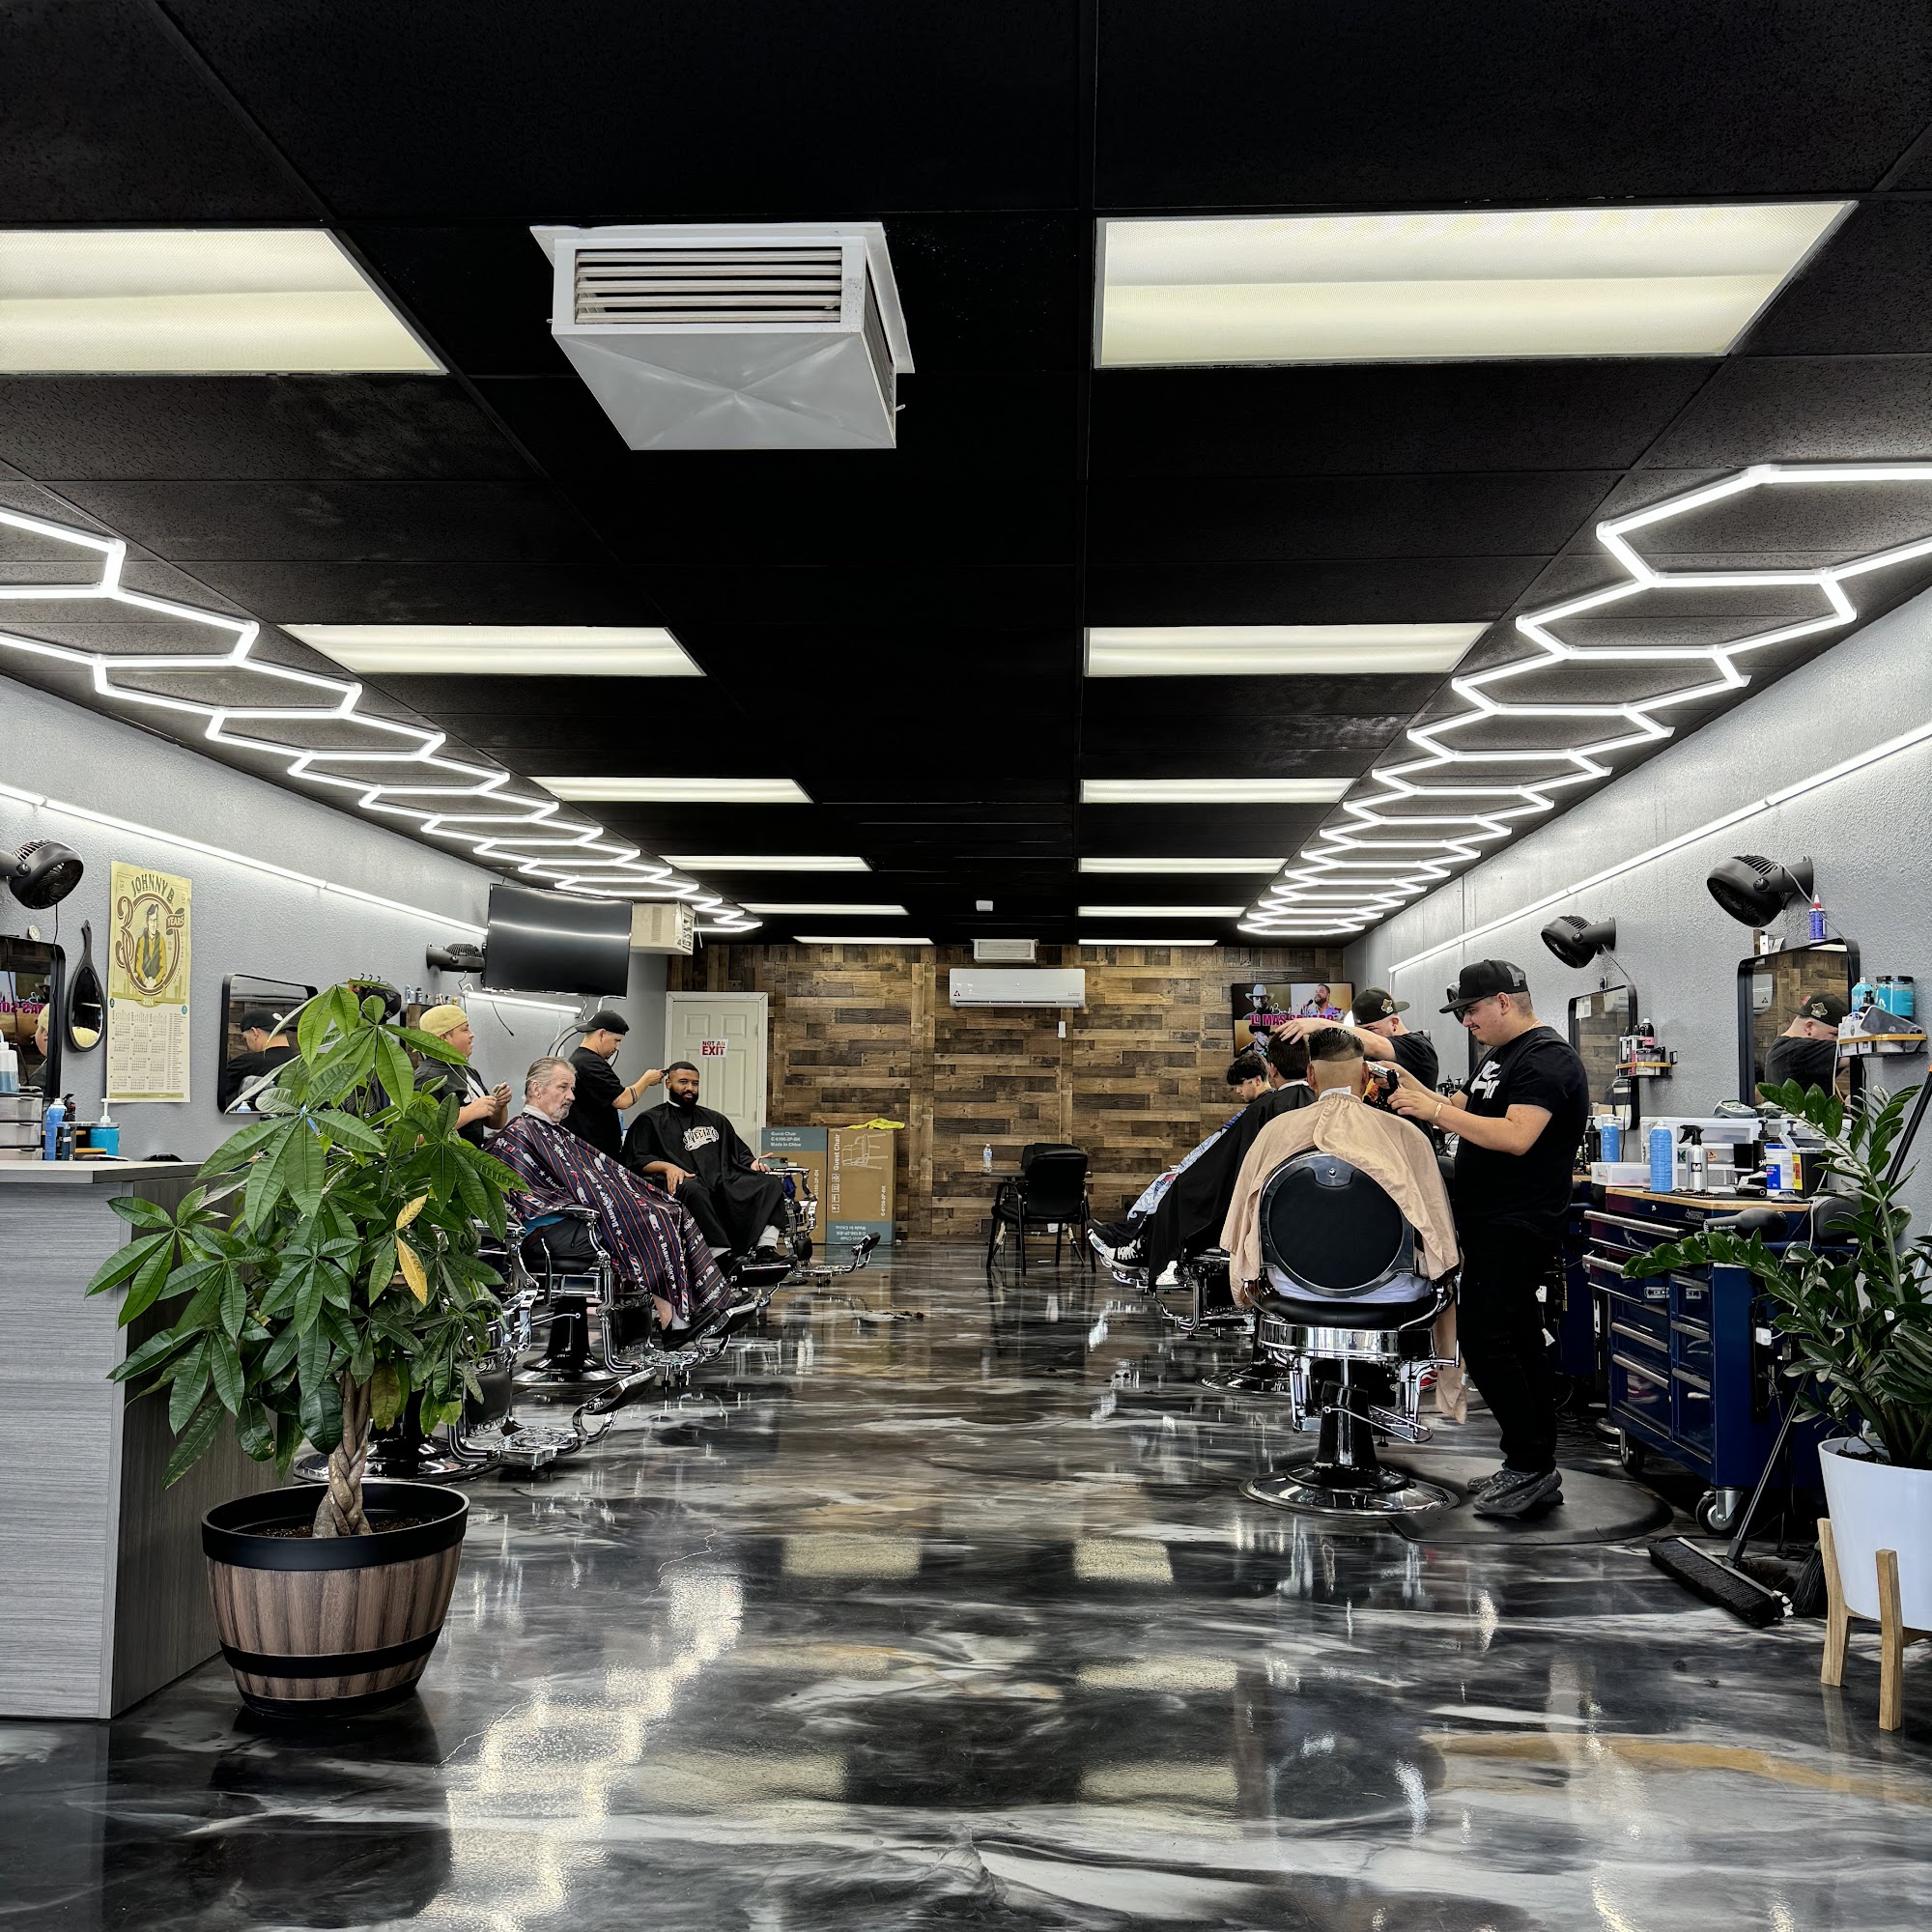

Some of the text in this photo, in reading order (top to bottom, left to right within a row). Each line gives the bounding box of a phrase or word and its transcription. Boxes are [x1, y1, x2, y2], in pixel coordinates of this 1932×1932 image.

[131, 873, 168, 897] JOHNNY
[167, 916, 185, 926] YEARS
[702, 1045, 725, 1056] EXIT
